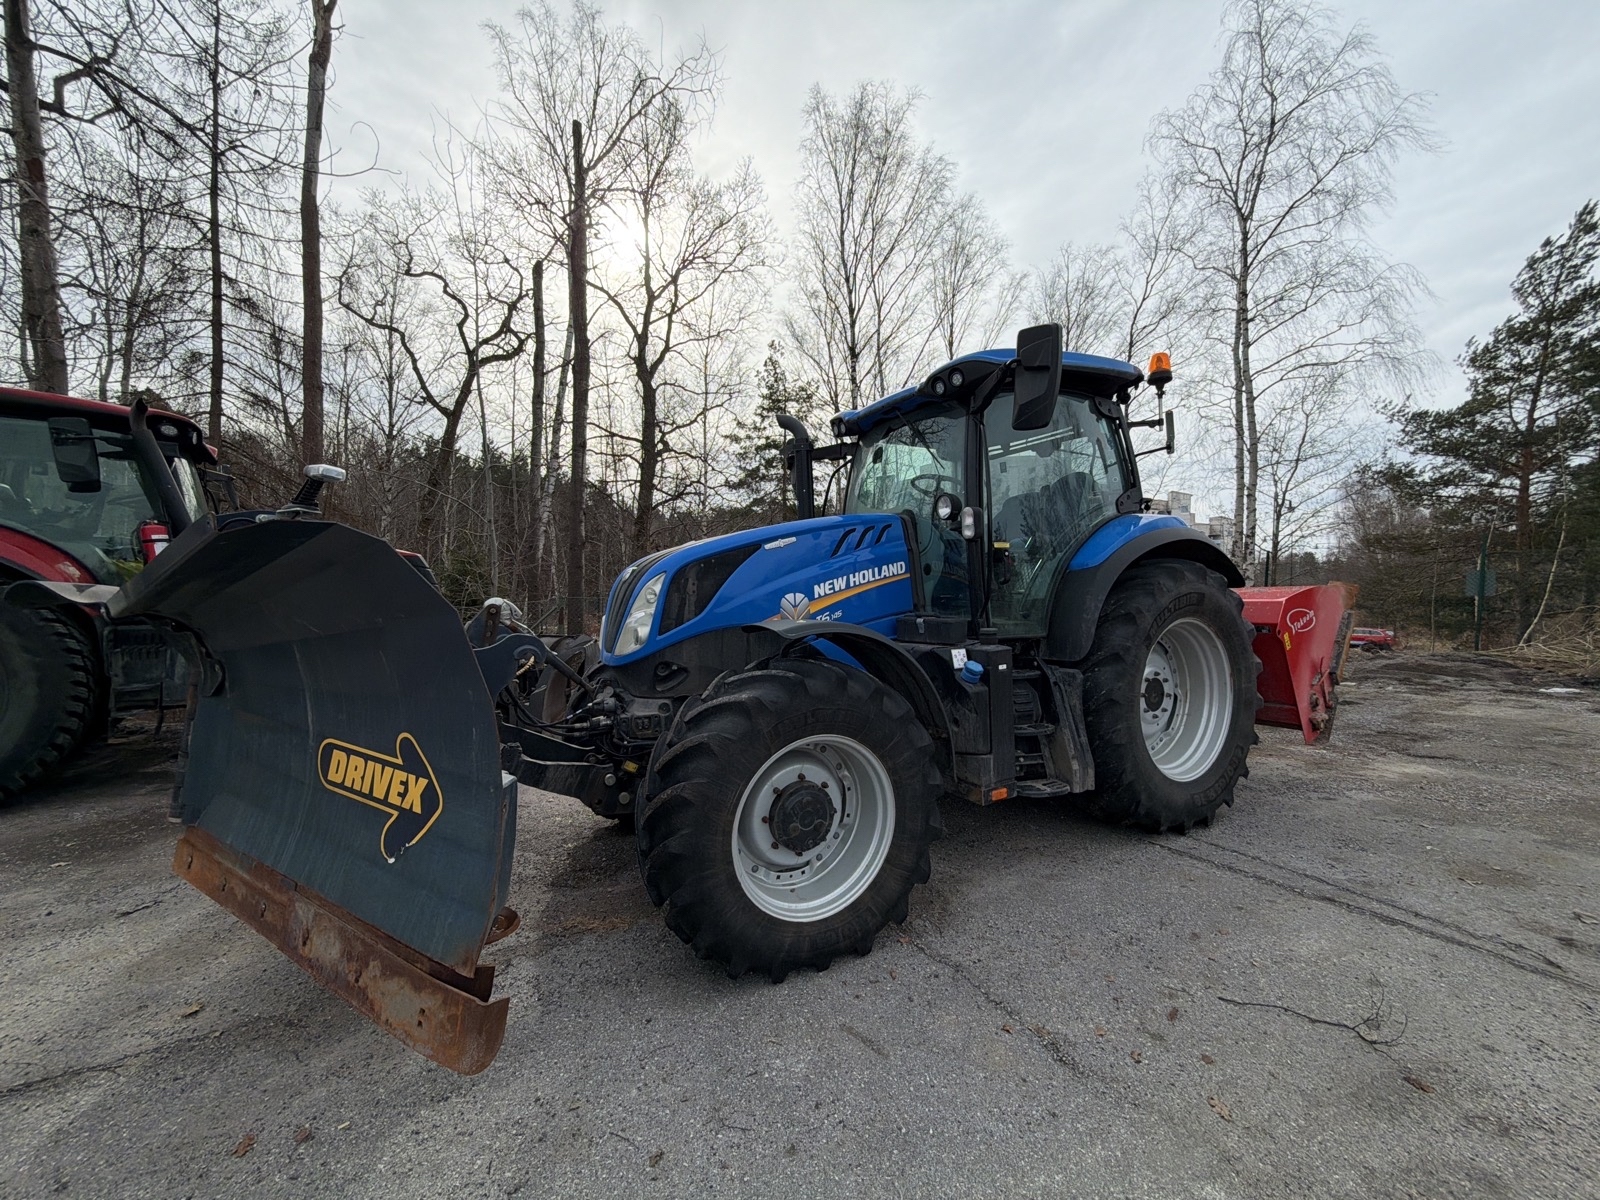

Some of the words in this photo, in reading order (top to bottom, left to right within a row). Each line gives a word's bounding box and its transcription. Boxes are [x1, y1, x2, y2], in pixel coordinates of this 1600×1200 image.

[814, 577, 847, 599] NEW
[849, 561, 906, 588] HOLLAND
[327, 749, 429, 814] DRIVEX
